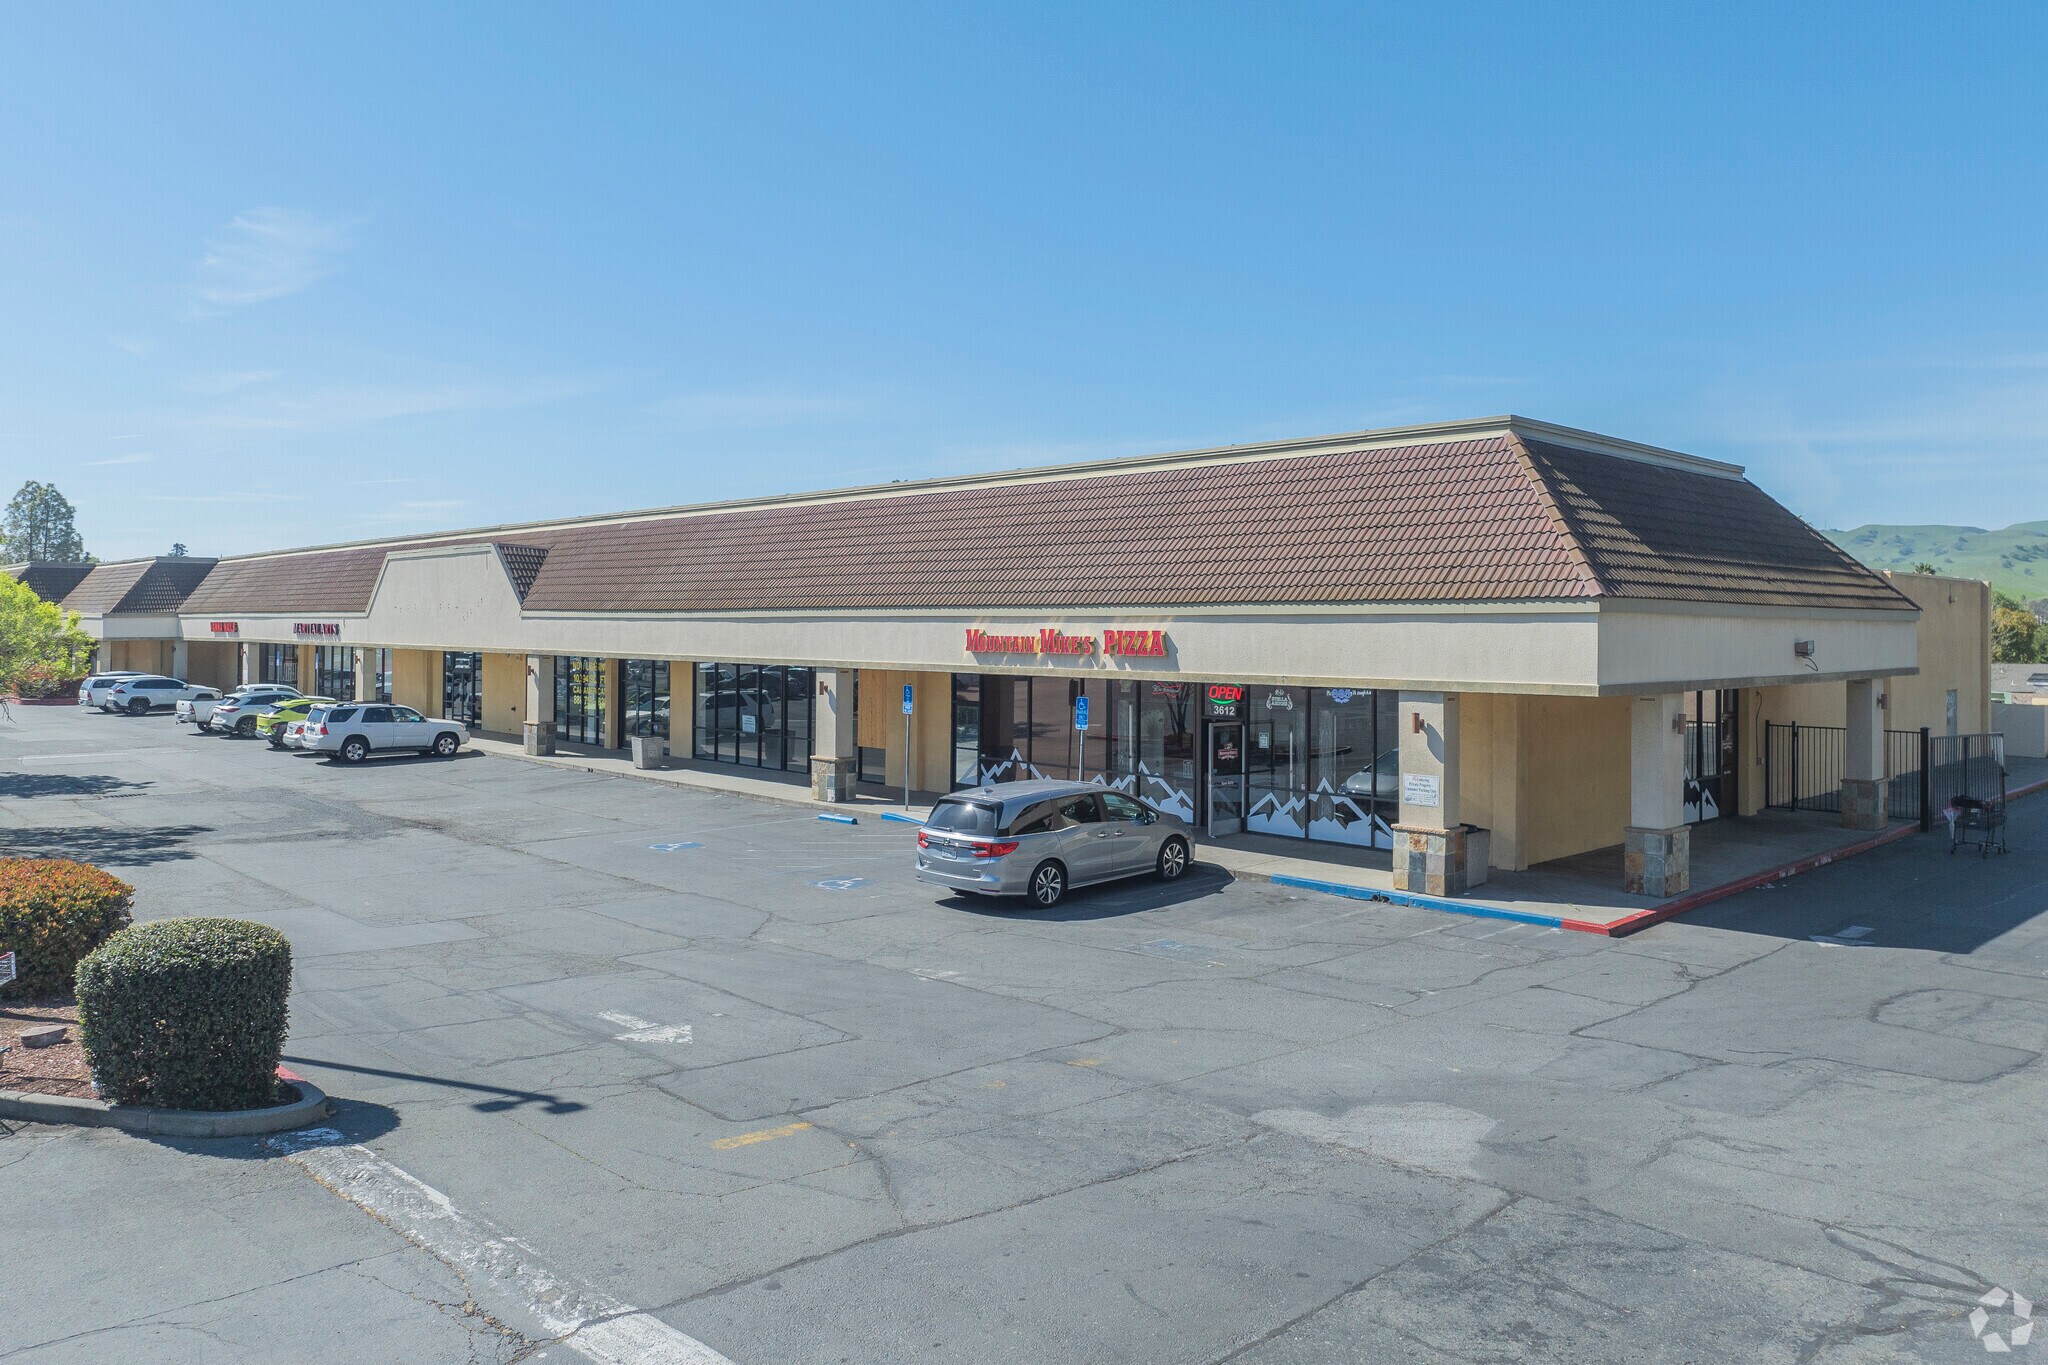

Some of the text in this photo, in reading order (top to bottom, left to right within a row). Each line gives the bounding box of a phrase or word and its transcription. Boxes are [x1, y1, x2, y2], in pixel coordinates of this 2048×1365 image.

[1103, 629, 1165, 657] PIZZA
[1209, 685, 1243, 700] OPEN
[1213, 705, 1235, 716] 3612
